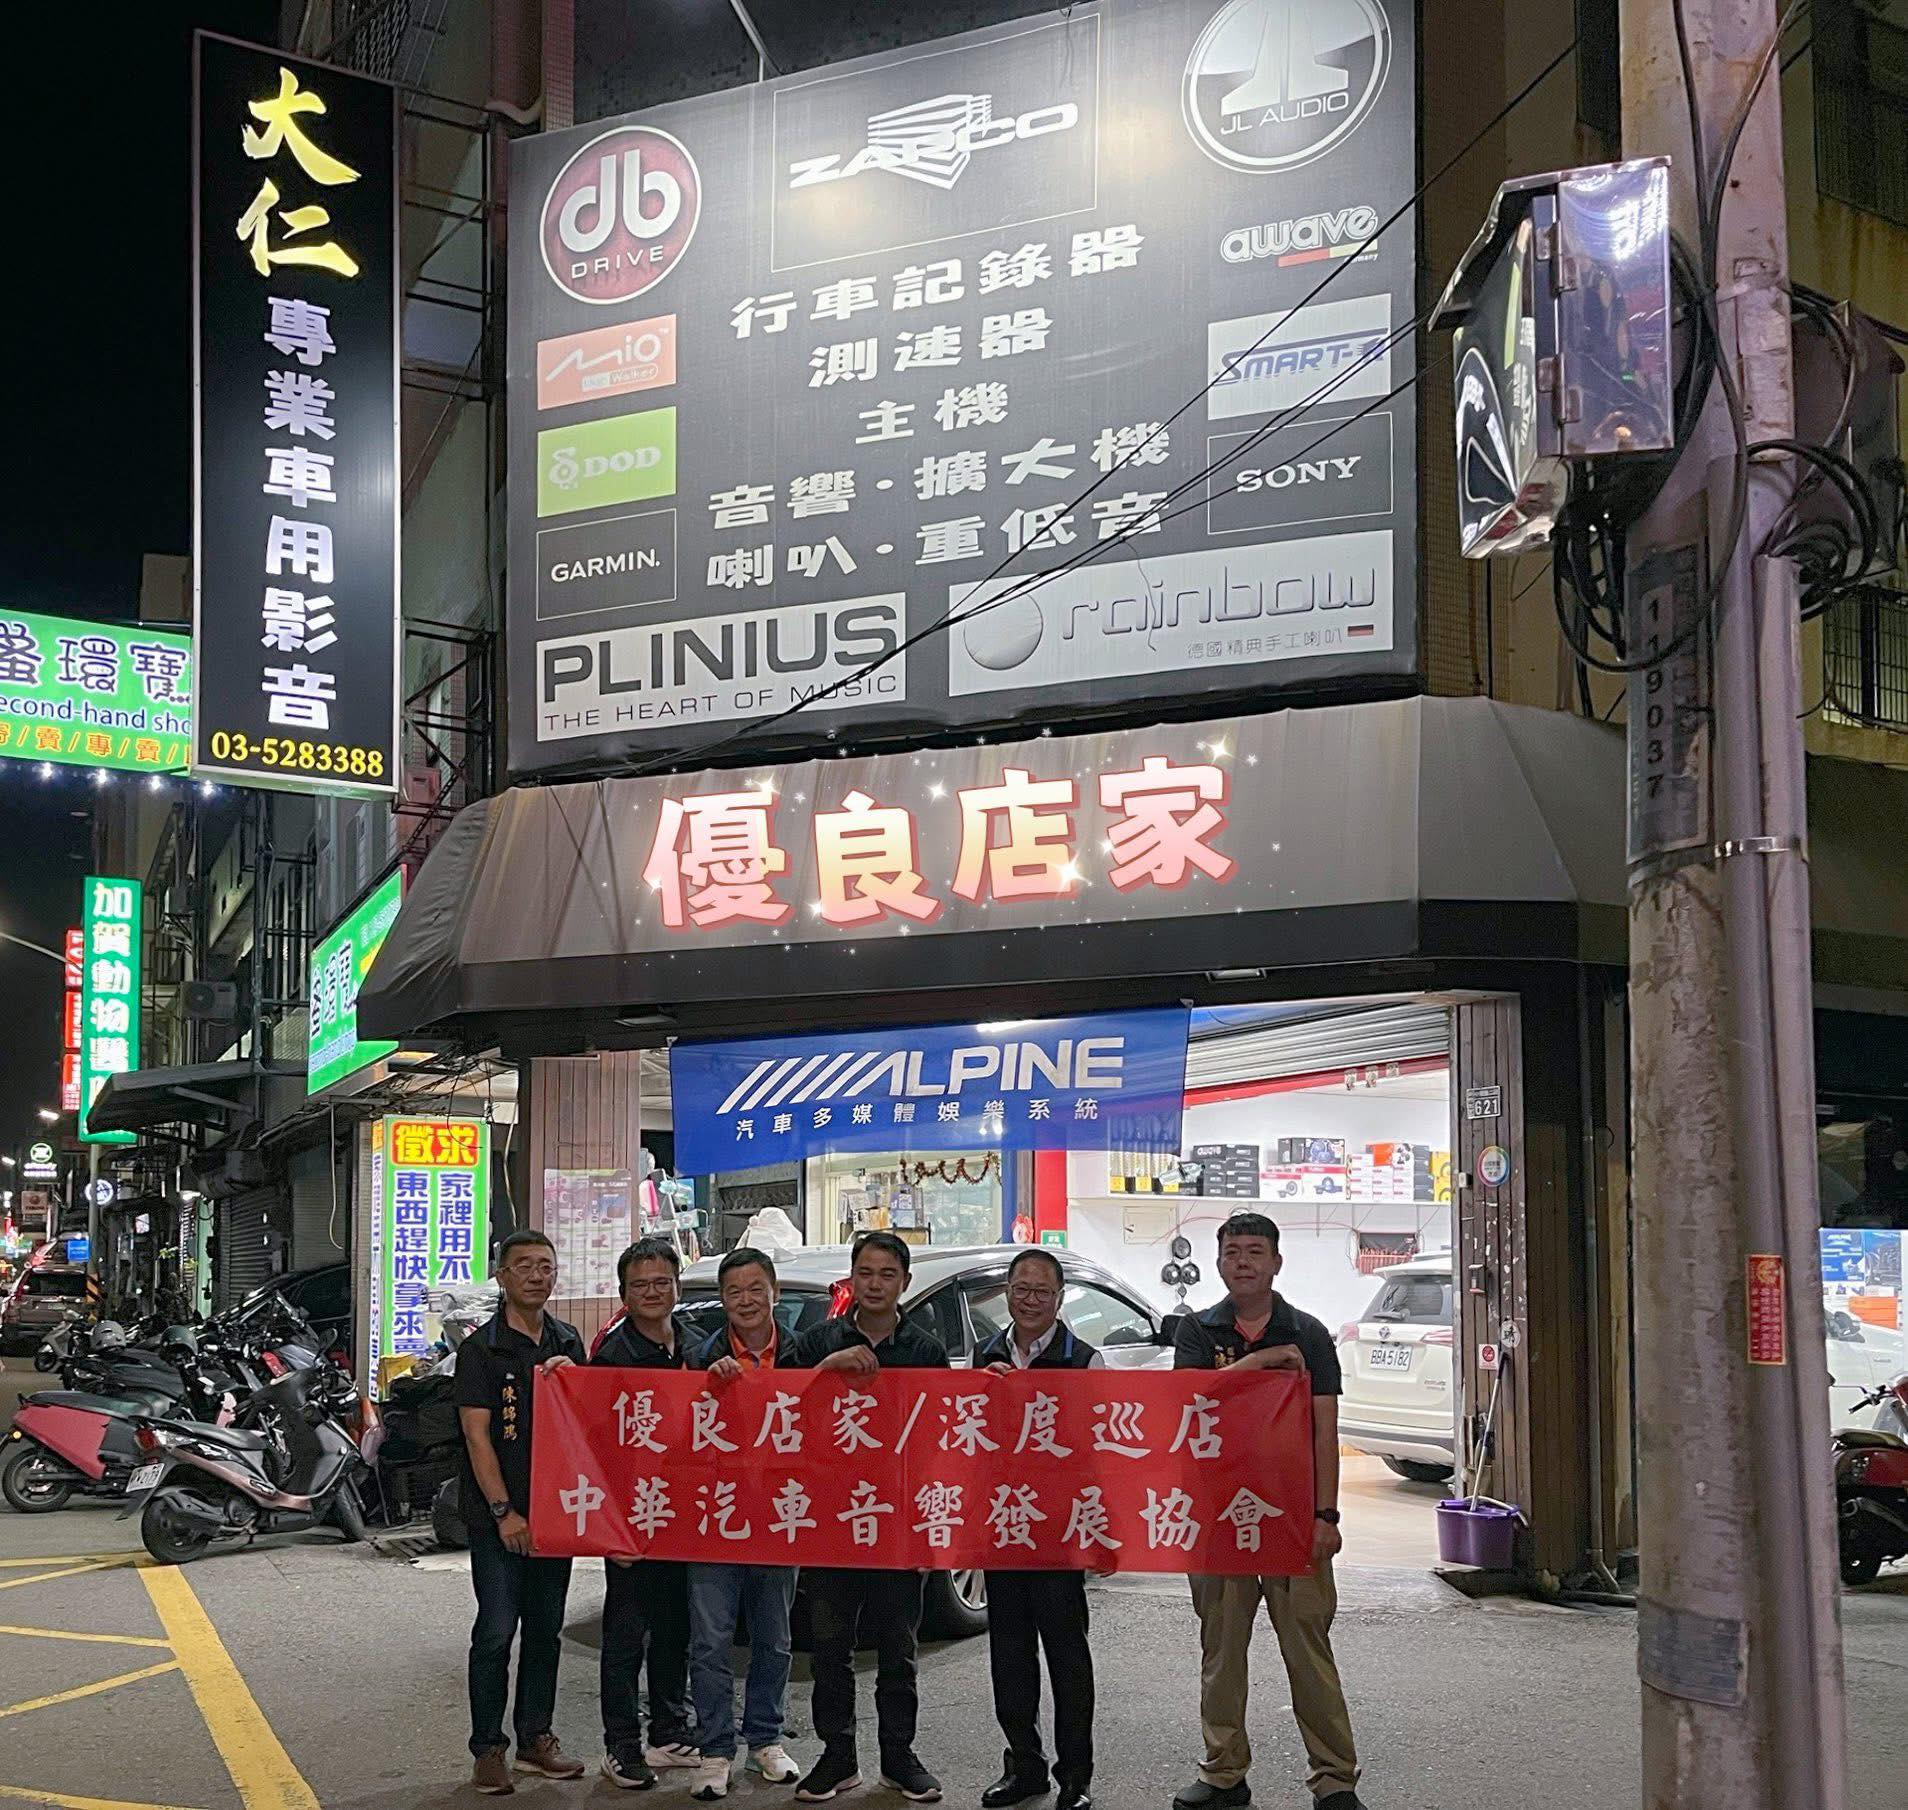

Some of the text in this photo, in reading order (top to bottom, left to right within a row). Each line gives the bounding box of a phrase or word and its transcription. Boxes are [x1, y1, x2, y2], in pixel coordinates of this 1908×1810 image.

[1221, 91, 1350, 136] JL AUDIO
[237, 65, 362, 278] 大仁
[559, 149, 681, 253] db
[571, 245, 665, 280] DRIVE
[1220, 206, 1378, 263] awave
[730, 224, 1145, 339] 行車記錄器
[808, 307, 1054, 388] 測速器
[856, 381, 1009, 444] 主機
[583, 446, 662, 478] DOD
[1236, 456, 1361, 494] SONY
[262, 295, 338, 732] 專業車用影音
[1063, 565, 1375, 640] rainbow
[545, 605, 898, 702] PLINIUS
[545, 674, 897, 731] THE HEART OF MUSIC
[211, 732, 384, 778] 03-5283388
[843, 1036, 1124, 1097] ALPINE
[736, 1097, 1098, 1141] 汽車多媒體娛樂系統
[1474, 1098, 1498, 1116] 621
[395, 1124, 474, 1164] 徵求
[612, 1389, 1223, 1455] 優良店家/深度巡店
[559, 1474, 1285, 1553] 中華汽車音響發展協會
